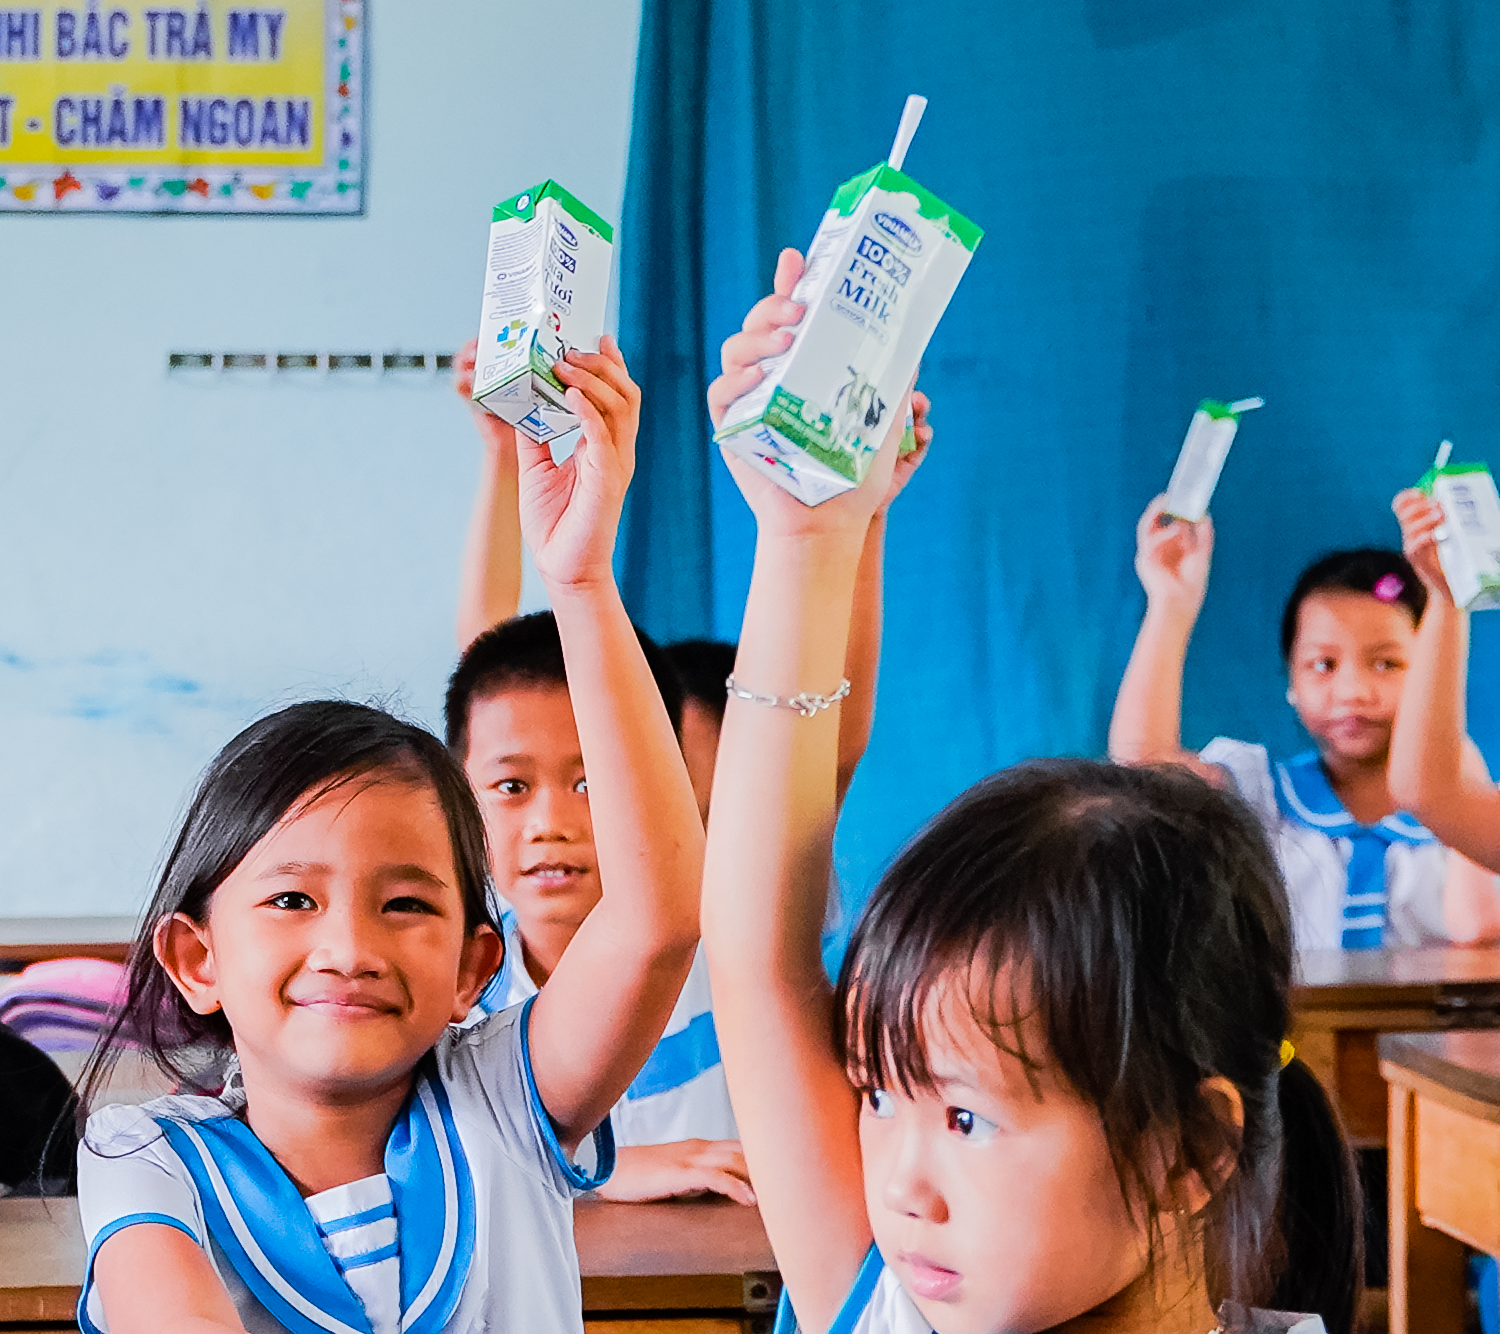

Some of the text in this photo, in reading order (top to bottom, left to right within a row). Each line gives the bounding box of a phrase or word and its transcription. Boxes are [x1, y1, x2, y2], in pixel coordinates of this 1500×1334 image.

[228, 11, 284, 60] MY
[56, 83, 164, 146] CHĂM
[180, 98, 310, 146] NGOAN
[849, 257, 899, 304] Fresh
[857, 236, 912, 286] 100%
[836, 277, 890, 324] Milk
